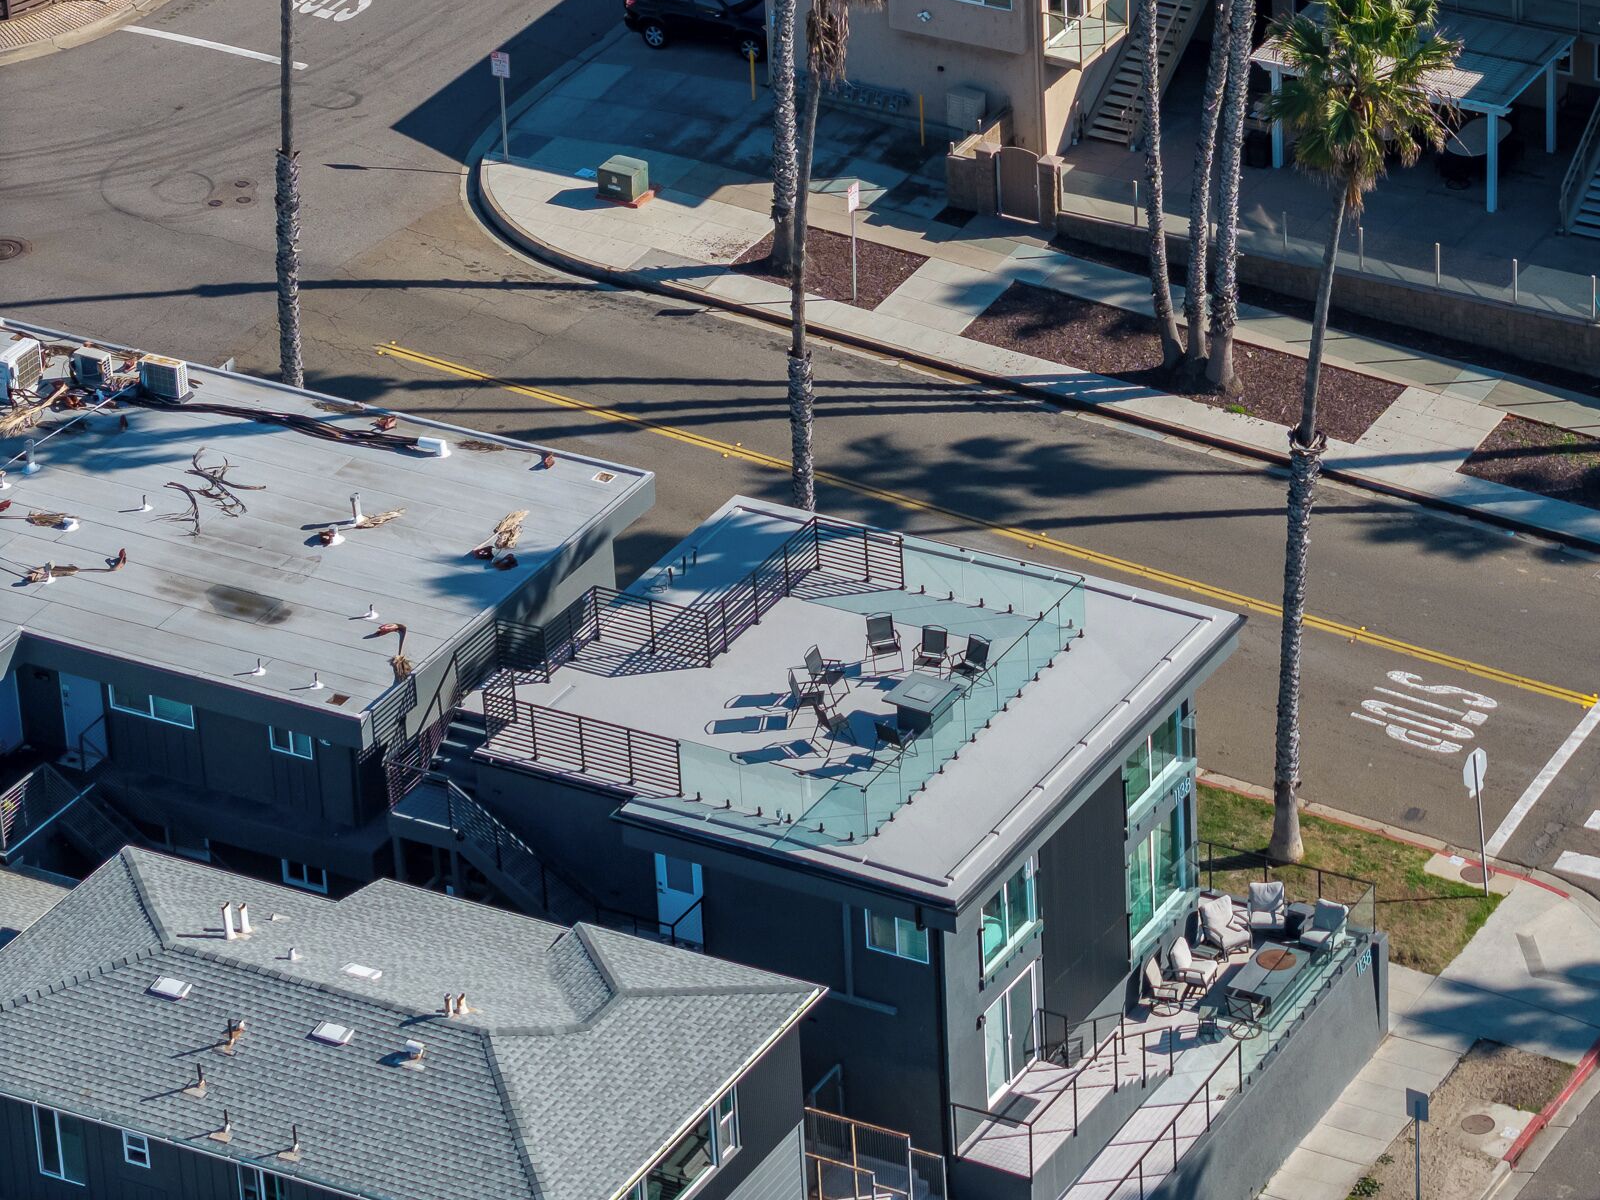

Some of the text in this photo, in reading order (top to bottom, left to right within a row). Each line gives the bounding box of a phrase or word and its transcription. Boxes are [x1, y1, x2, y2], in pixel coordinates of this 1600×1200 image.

[1350, 670, 1498, 753] STOP
[1174, 777, 1191, 805] 1138
[1356, 949, 1372, 977] 1138
